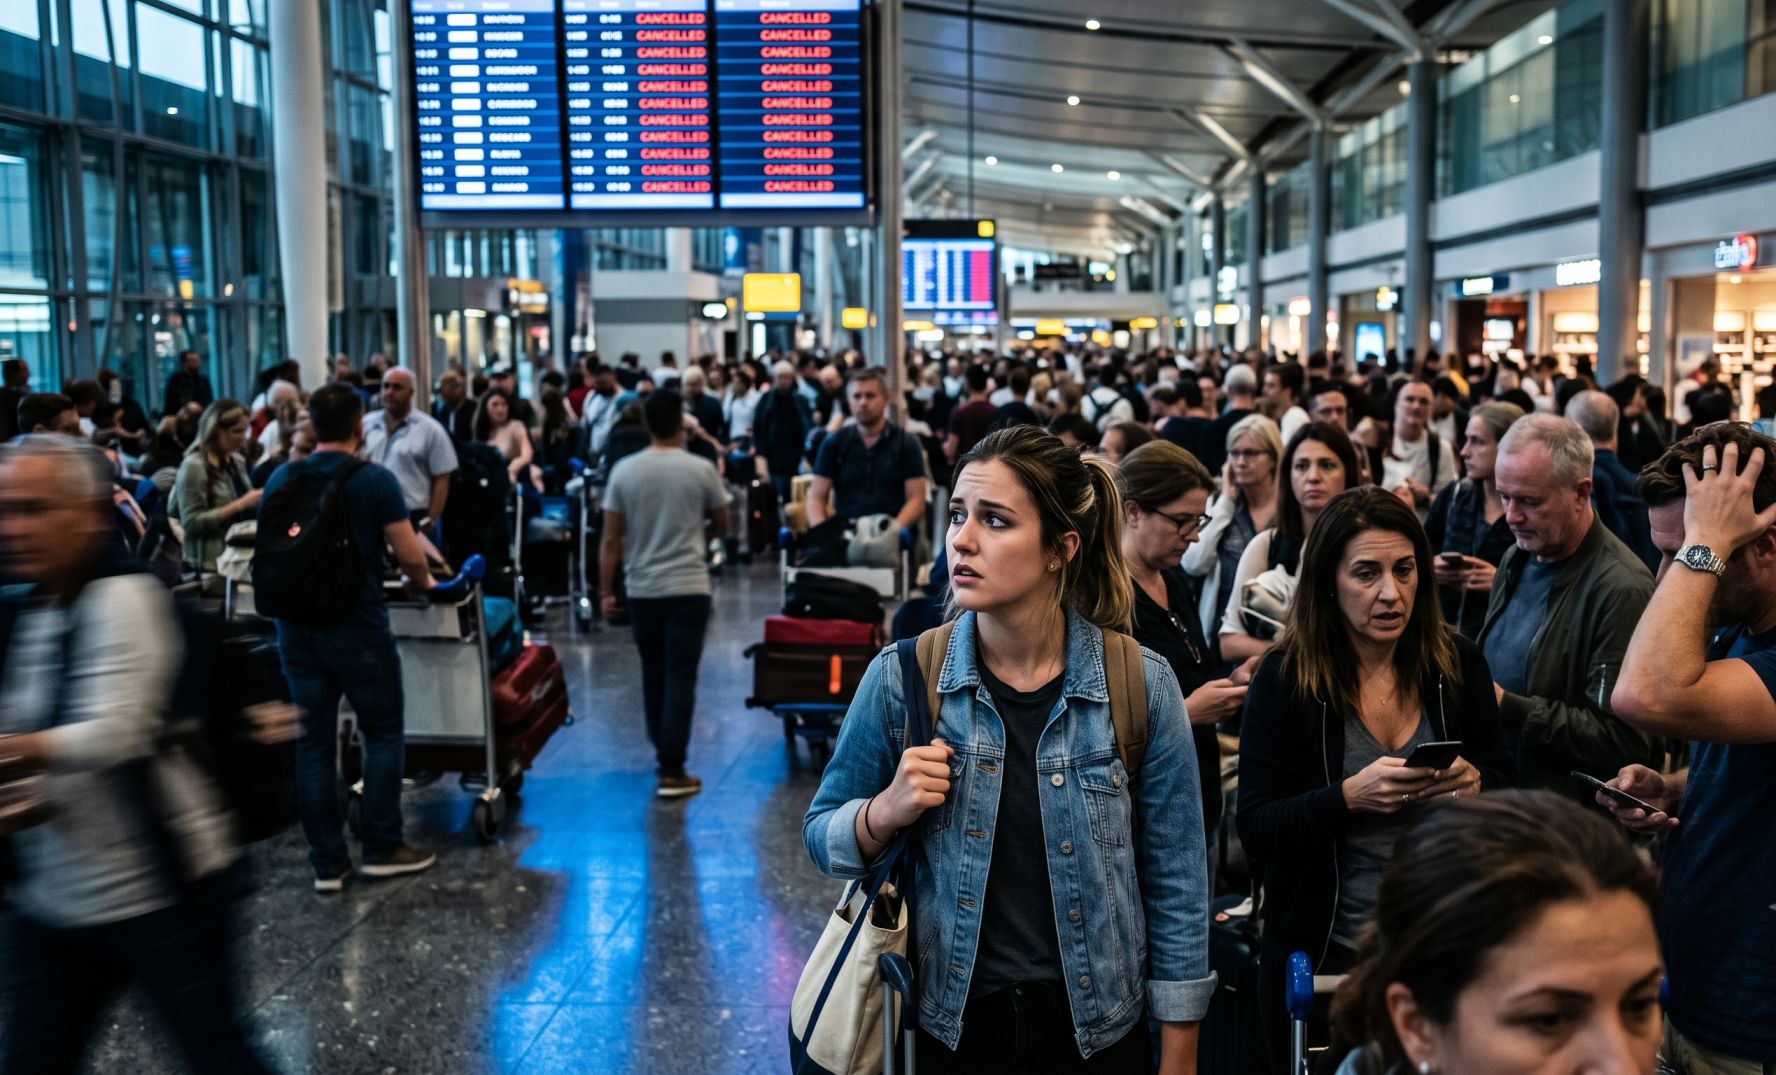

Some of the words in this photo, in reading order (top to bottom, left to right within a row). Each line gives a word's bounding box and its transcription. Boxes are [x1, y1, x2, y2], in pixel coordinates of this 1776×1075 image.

[635, 12, 706, 25] CANCELLED
[759, 12, 832, 25] CANCELLED
[635, 29, 707, 42] CANCELLED
[759, 29, 832, 42] CANCELLED
[636, 46, 707, 59] CANCELLED
[760, 45, 832, 59] CANCELLED
[636, 63, 707, 76] CANCELLED
[760, 63, 833, 76] CANCELLED
[637, 80, 708, 93] CANCELLED
[761, 80, 833, 93] CANCELLED
[638, 97, 709, 110] CANCELLED
[761, 96, 833, 109] CANCELLED
[639, 114, 709, 126] CANCELLED
[761, 113, 833, 126] CANCELLED
[639, 130, 710, 143] CANCELLED
[762, 130, 834, 143] CANCELLED
[640, 147, 710, 160] CANCELLED
[762, 147, 834, 160] CANCELLED
[640, 164, 711, 177] CANCELLED
[763, 163, 834, 176] CANCELLED
[641, 180, 711, 193] CANCELLED
[763, 180, 835, 193] CANCELLED
